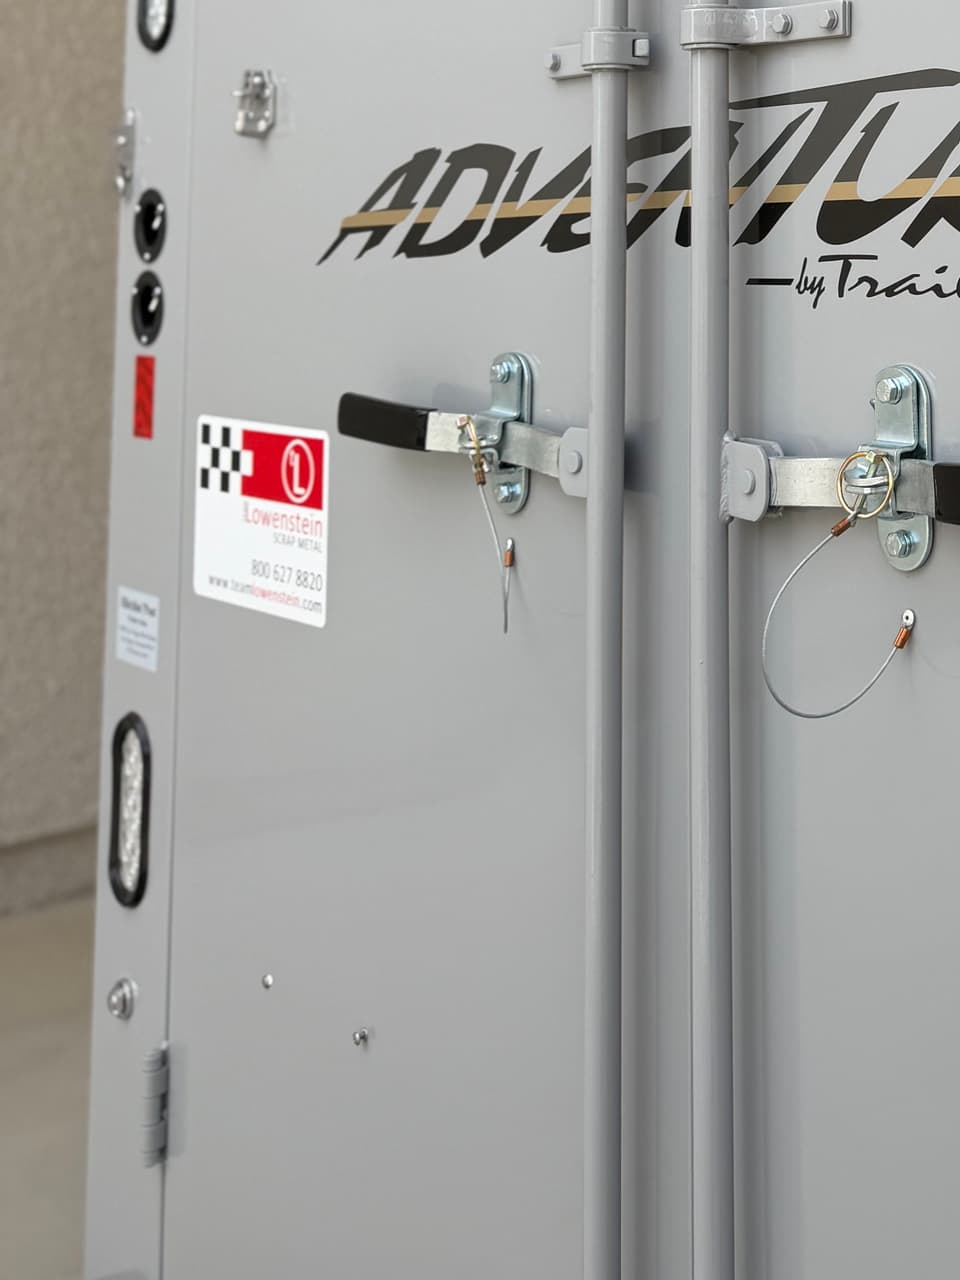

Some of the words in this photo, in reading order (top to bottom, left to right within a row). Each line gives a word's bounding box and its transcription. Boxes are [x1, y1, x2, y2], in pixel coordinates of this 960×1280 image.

[243, 501, 323, 538] Lowenstein
[251, 559, 271, 580] 800
[273, 564, 293, 585] 627
[295, 569, 323, 592] 8820
